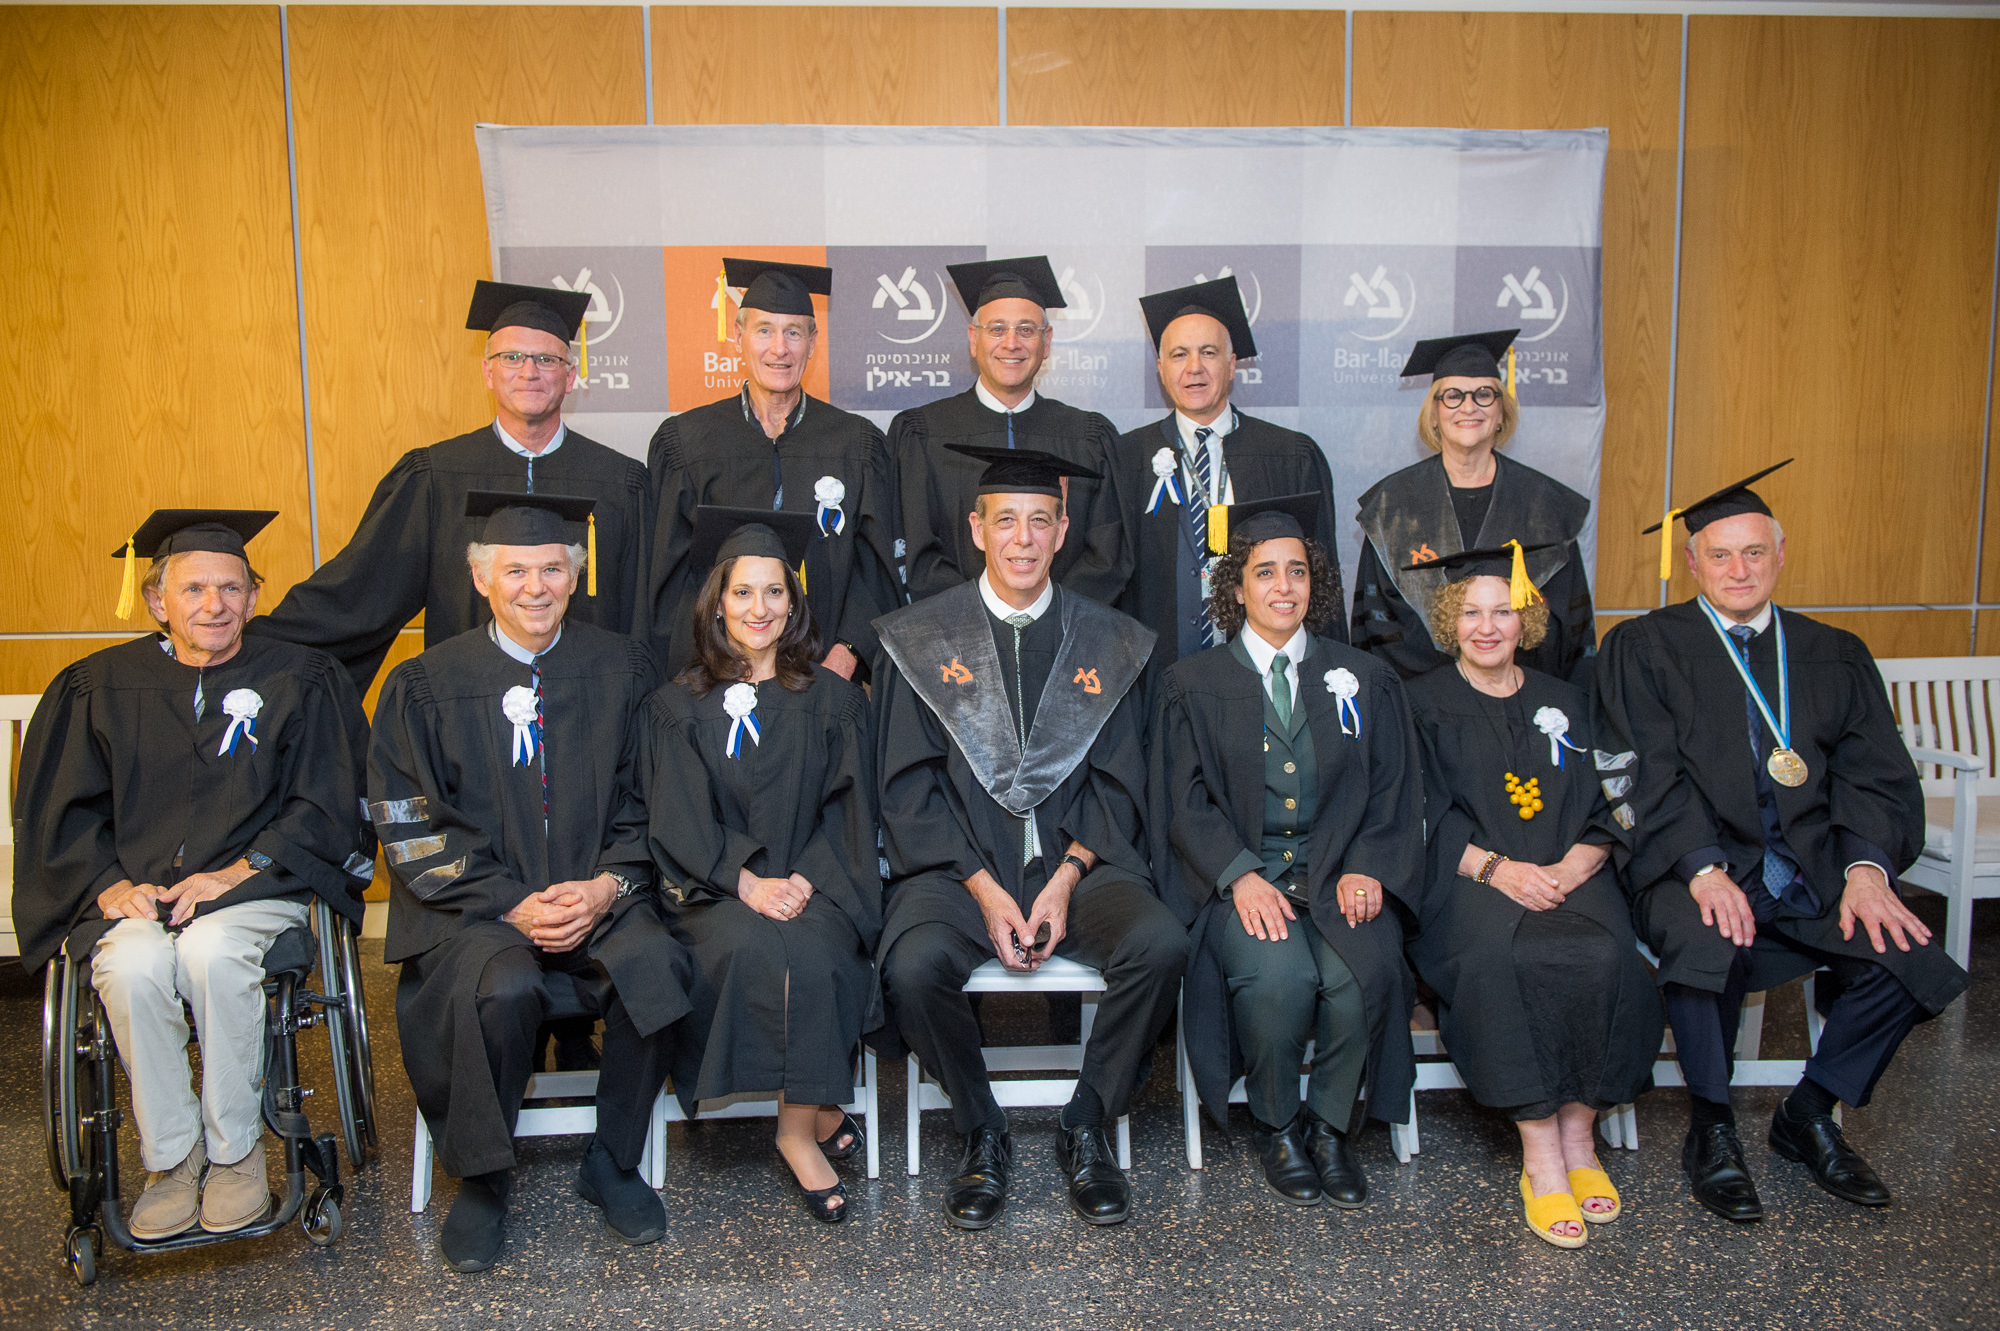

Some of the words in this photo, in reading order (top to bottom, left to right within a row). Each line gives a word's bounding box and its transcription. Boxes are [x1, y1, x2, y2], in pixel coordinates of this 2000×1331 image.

[572, 355, 629, 367] אוניבס
[704, 352, 746, 373] Bar-
[865, 353, 951, 365] אוניברסיטת
[1040, 349, 1108, 371] ar-Ilan
[1501, 351, 1569, 363] אוניברס
[572, 372, 630, 390] בר-א
[866, 366, 951, 392] בר-אילן
[1035, 373, 1108, 389] niversity
